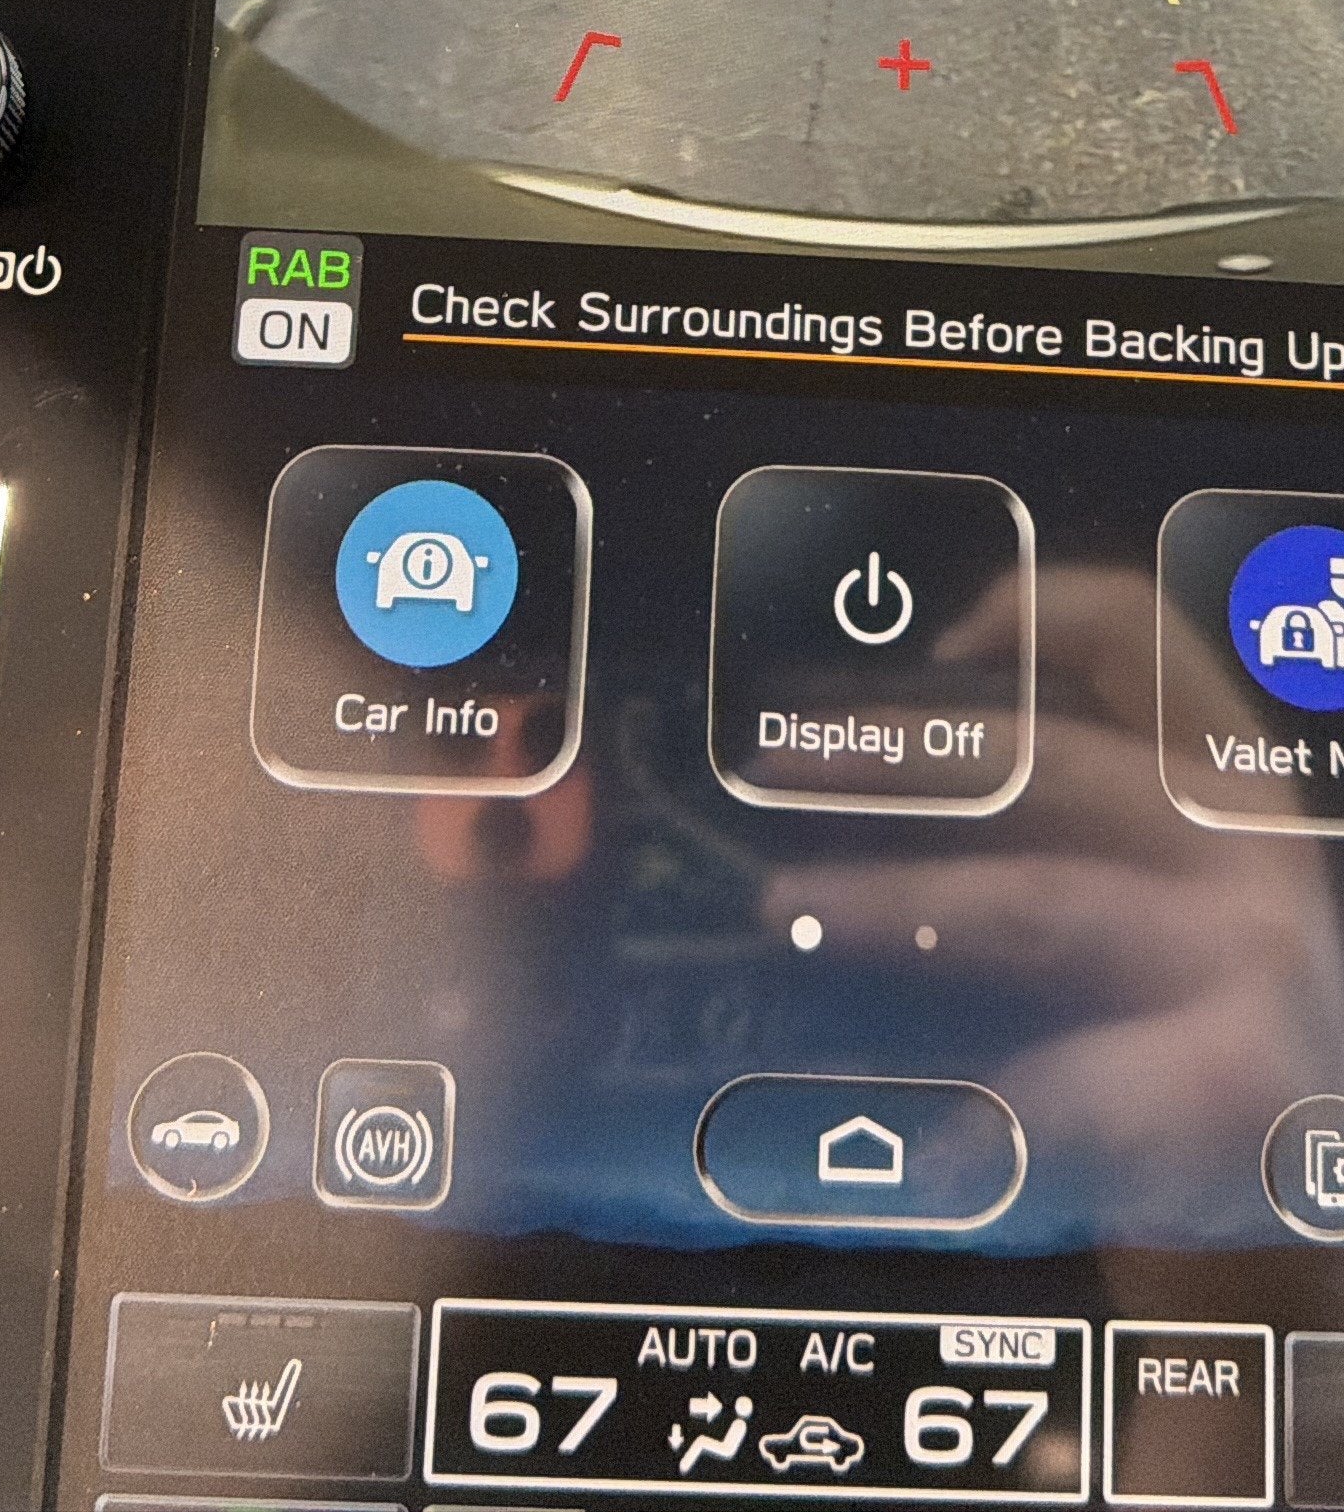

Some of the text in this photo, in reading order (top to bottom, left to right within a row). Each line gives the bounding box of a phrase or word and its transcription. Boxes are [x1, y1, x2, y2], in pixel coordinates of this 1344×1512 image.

[247, 246, 351, 288] RAB
[259, 311, 330, 350] ON
[412, 283, 555, 329] Check
[579, 292, 882, 353] Surroundings
[905, 309, 1062, 355] Before
[1086, 319, 1264, 378] Backing
[334, 694, 499, 737] Car Info
[759, 712, 984, 761] Display Off
[1206, 734, 1312, 775] Valet
[358, 1129, 410, 1163] AVH
[638, 1327, 1043, 1373] AUTO A/C SYNC
[1138, 1358, 1239, 1397] REAR
[469, 1372, 617, 1454] 67
[904, 1386, 1049, 1466] 67
